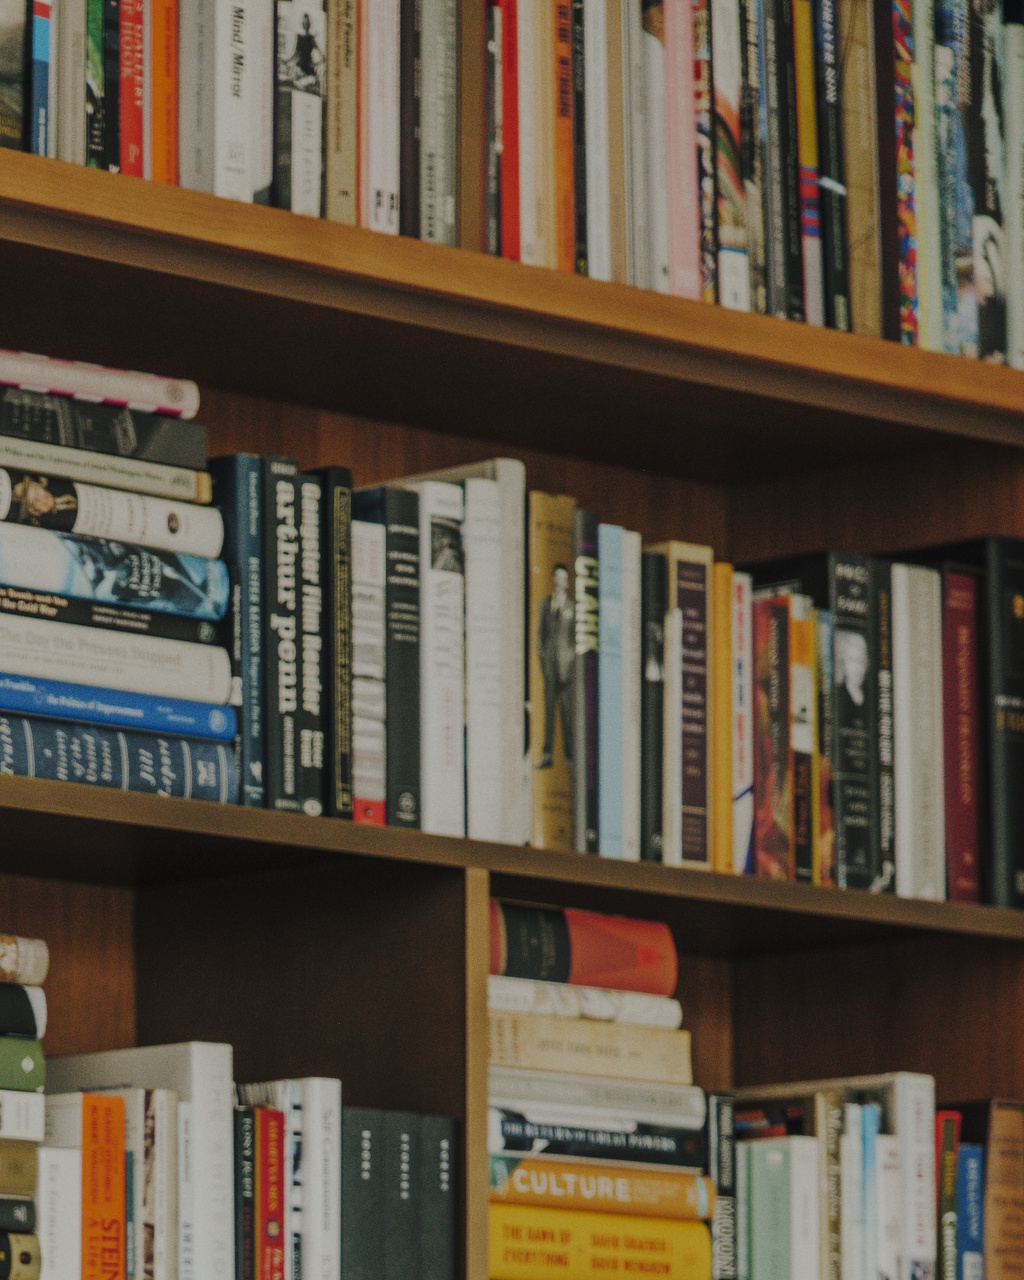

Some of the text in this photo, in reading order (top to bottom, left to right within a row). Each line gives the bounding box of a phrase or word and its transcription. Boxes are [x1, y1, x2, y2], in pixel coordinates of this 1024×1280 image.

[233, 7, 244, 99] Mind Mirror
[514, 1169, 631, 1202] CULTURE
